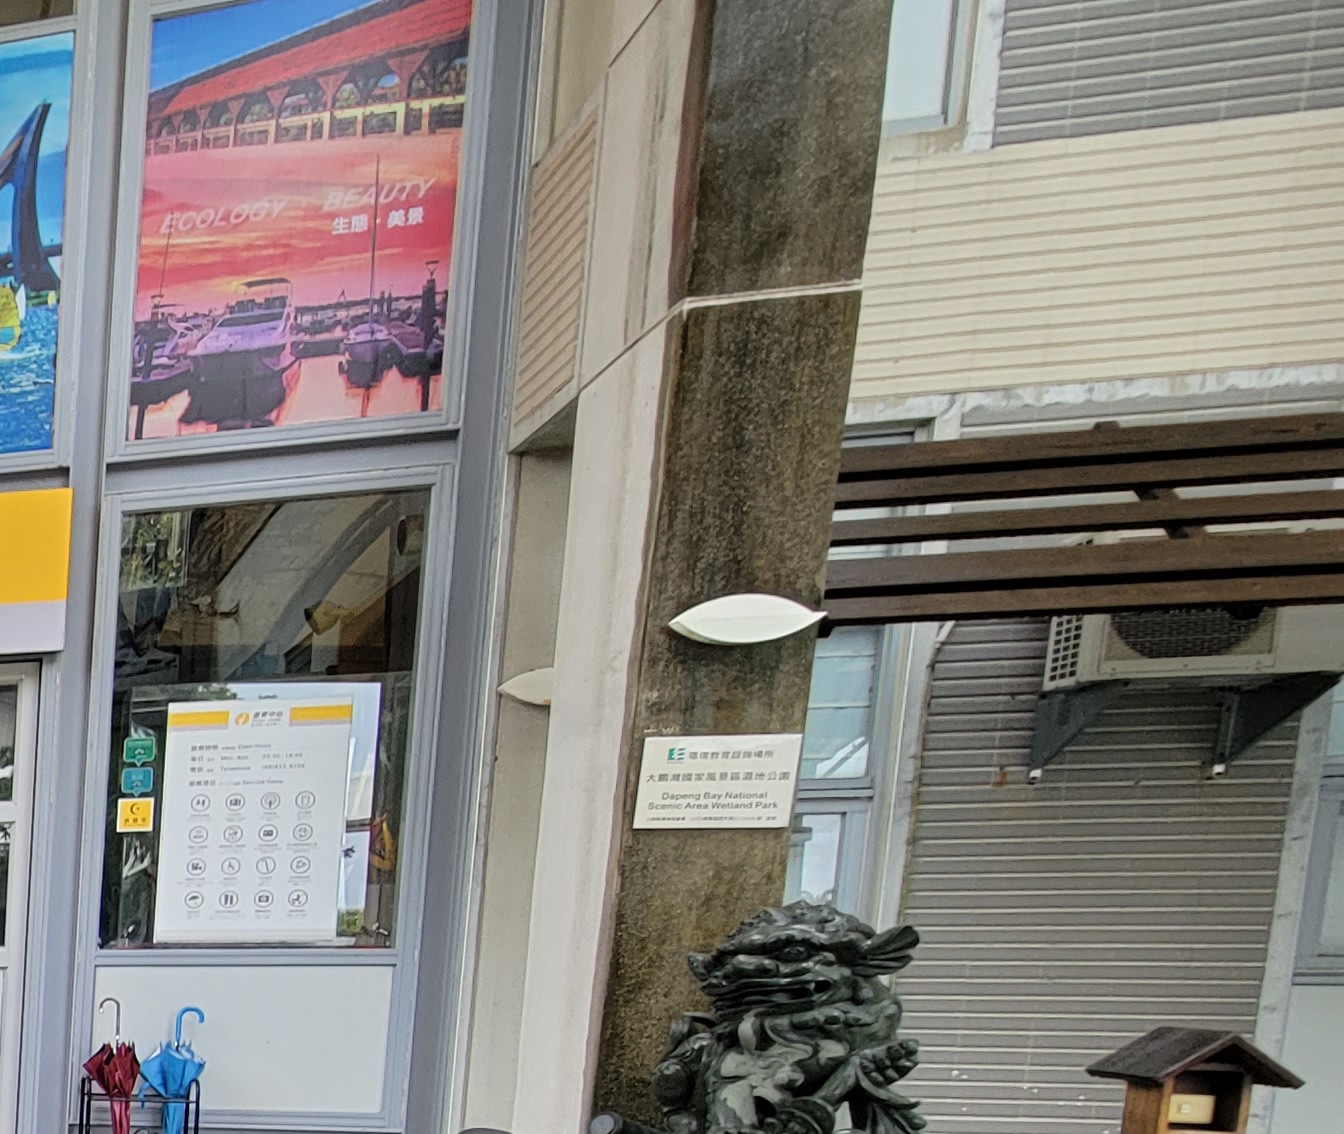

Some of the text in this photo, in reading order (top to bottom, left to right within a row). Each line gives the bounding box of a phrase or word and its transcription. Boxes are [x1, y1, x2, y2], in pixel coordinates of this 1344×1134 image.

[160, 177, 435, 233] ECOLOGY BEAUTY
[662, 791, 767, 801] Dapeng Bay National
[648, 801, 778, 810] Scenic Area Wetland Park
